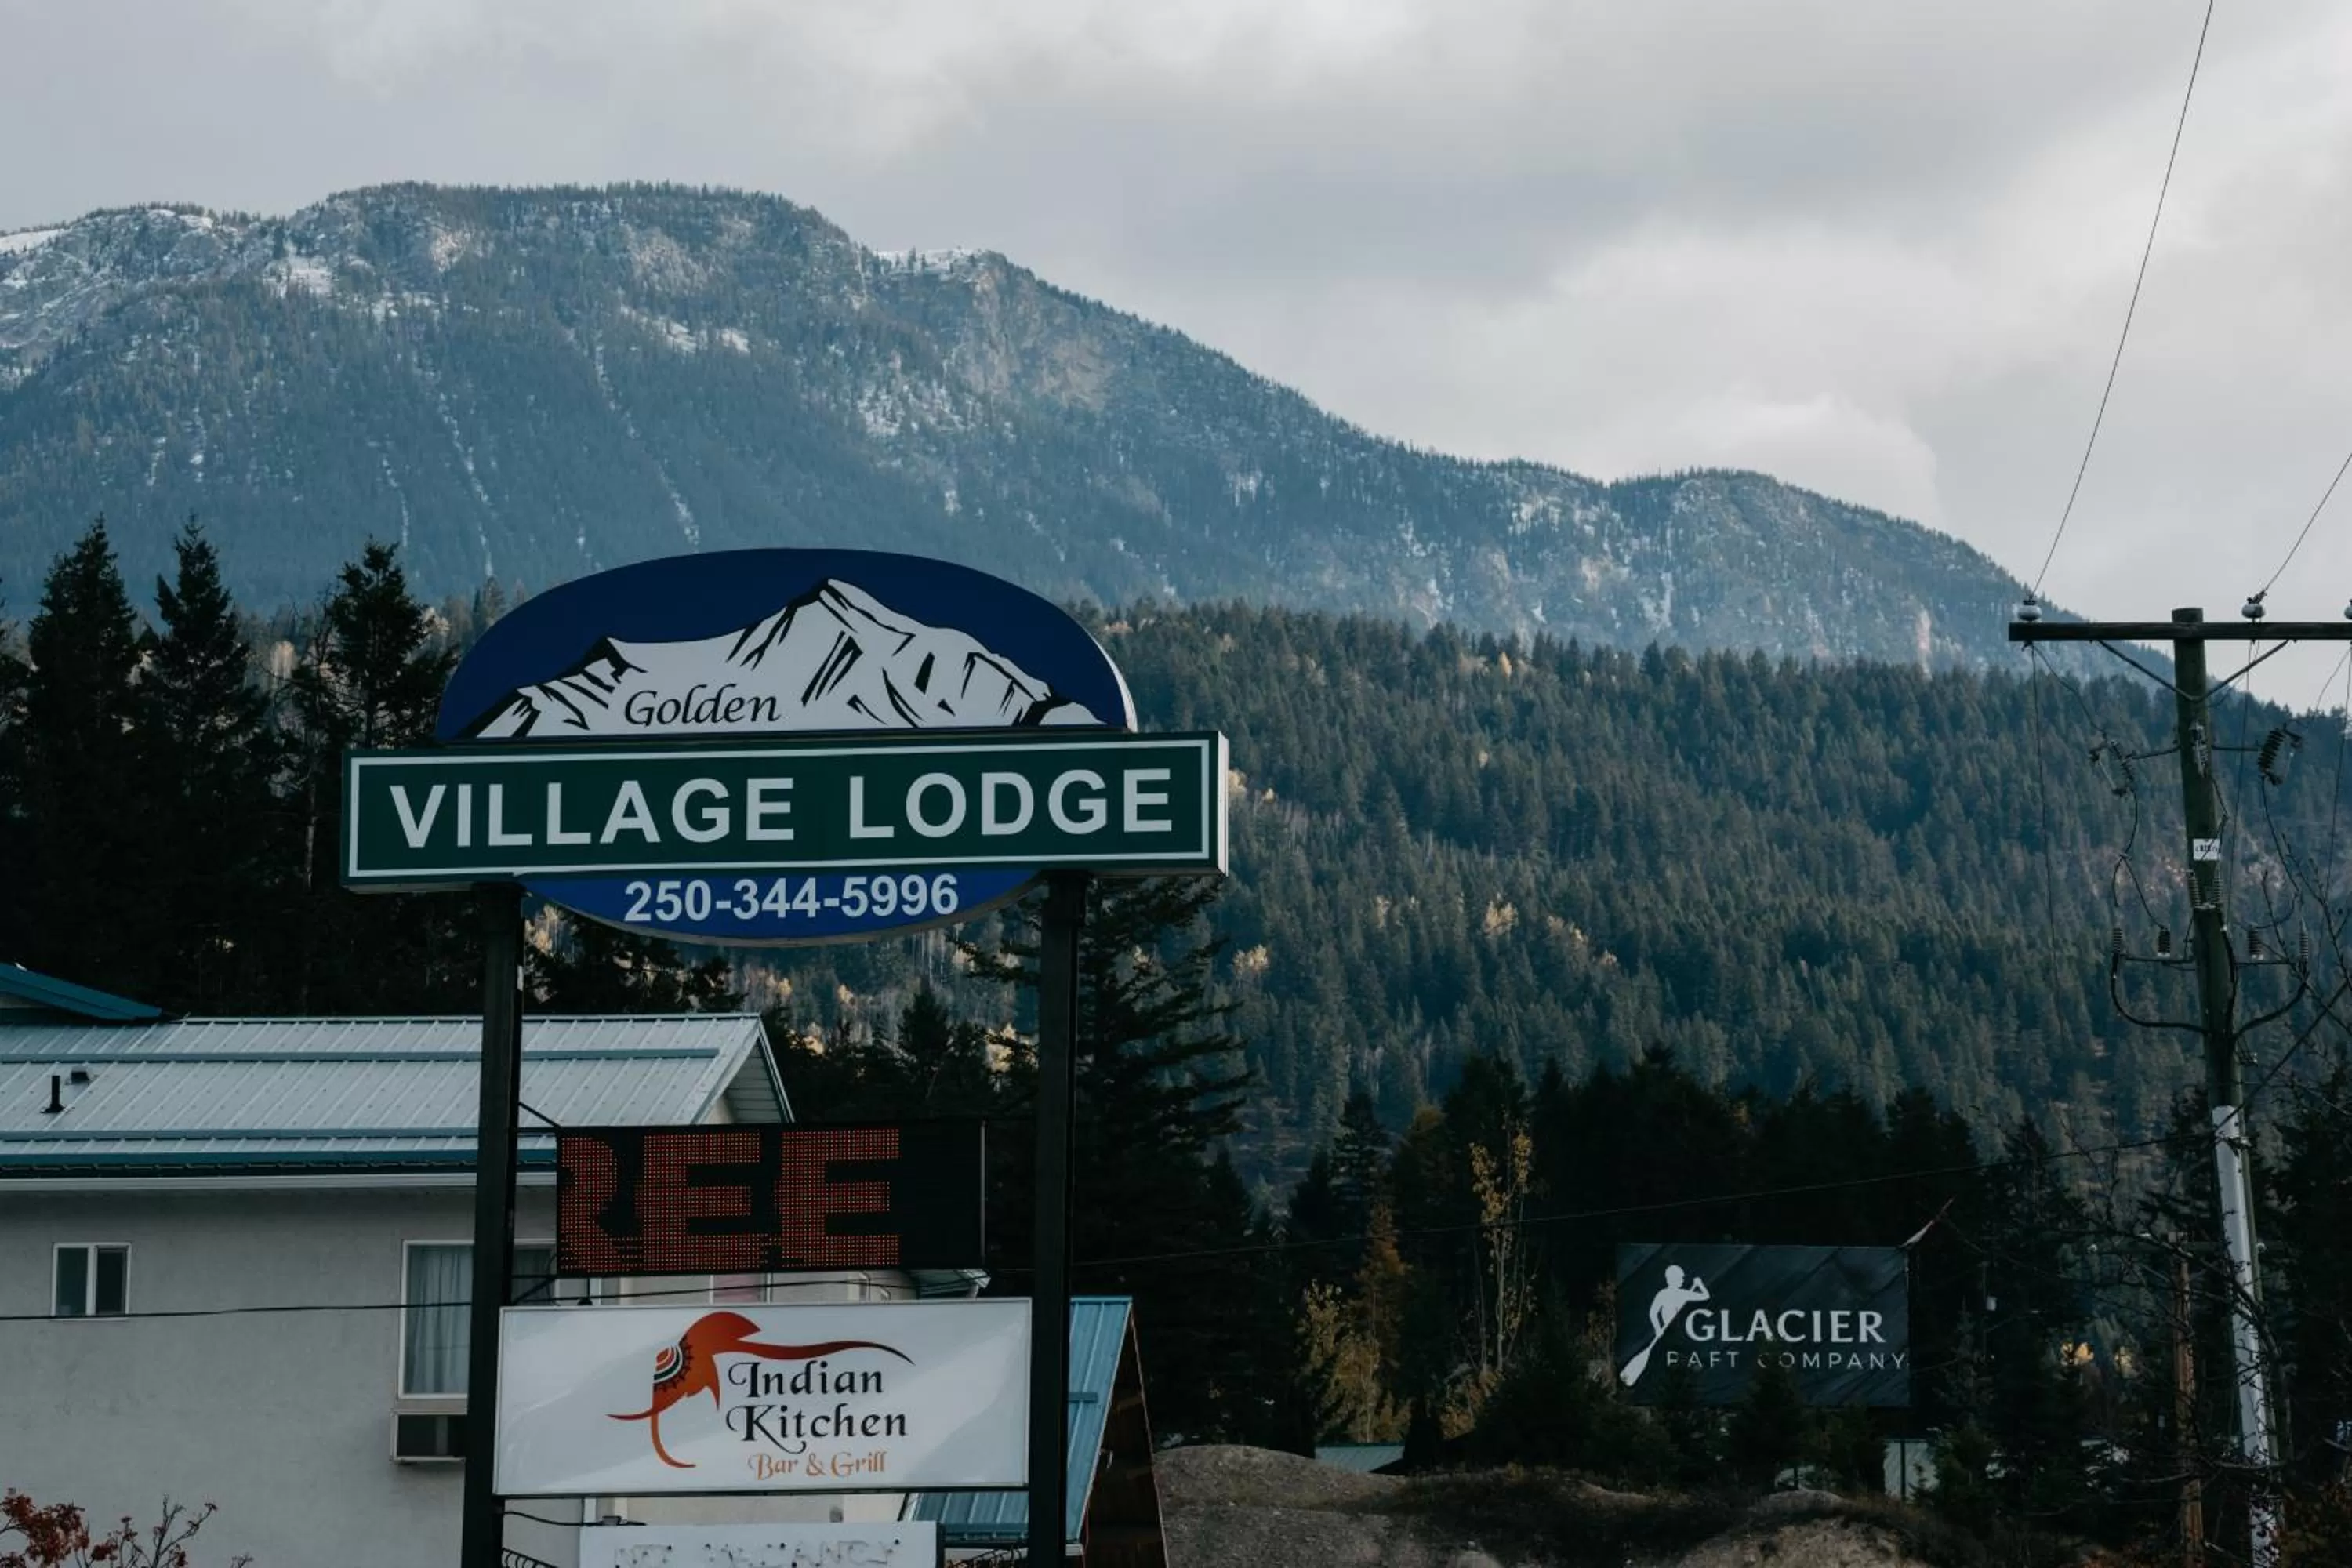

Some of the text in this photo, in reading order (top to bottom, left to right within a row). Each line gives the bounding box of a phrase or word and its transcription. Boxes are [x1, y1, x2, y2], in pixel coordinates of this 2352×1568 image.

[624, 683, 782, 726] Golden
[390, 768, 1173, 849] VILLAGE LODGE
[624, 873, 960, 924] 250-344-5996
[1685, 1308, 1886, 1343] GLACIER
[728, 1360, 884, 1398] Indian
[726, 1403, 909, 1454] Kitchen
[747, 1451, 887, 1480] Bar & Grill
